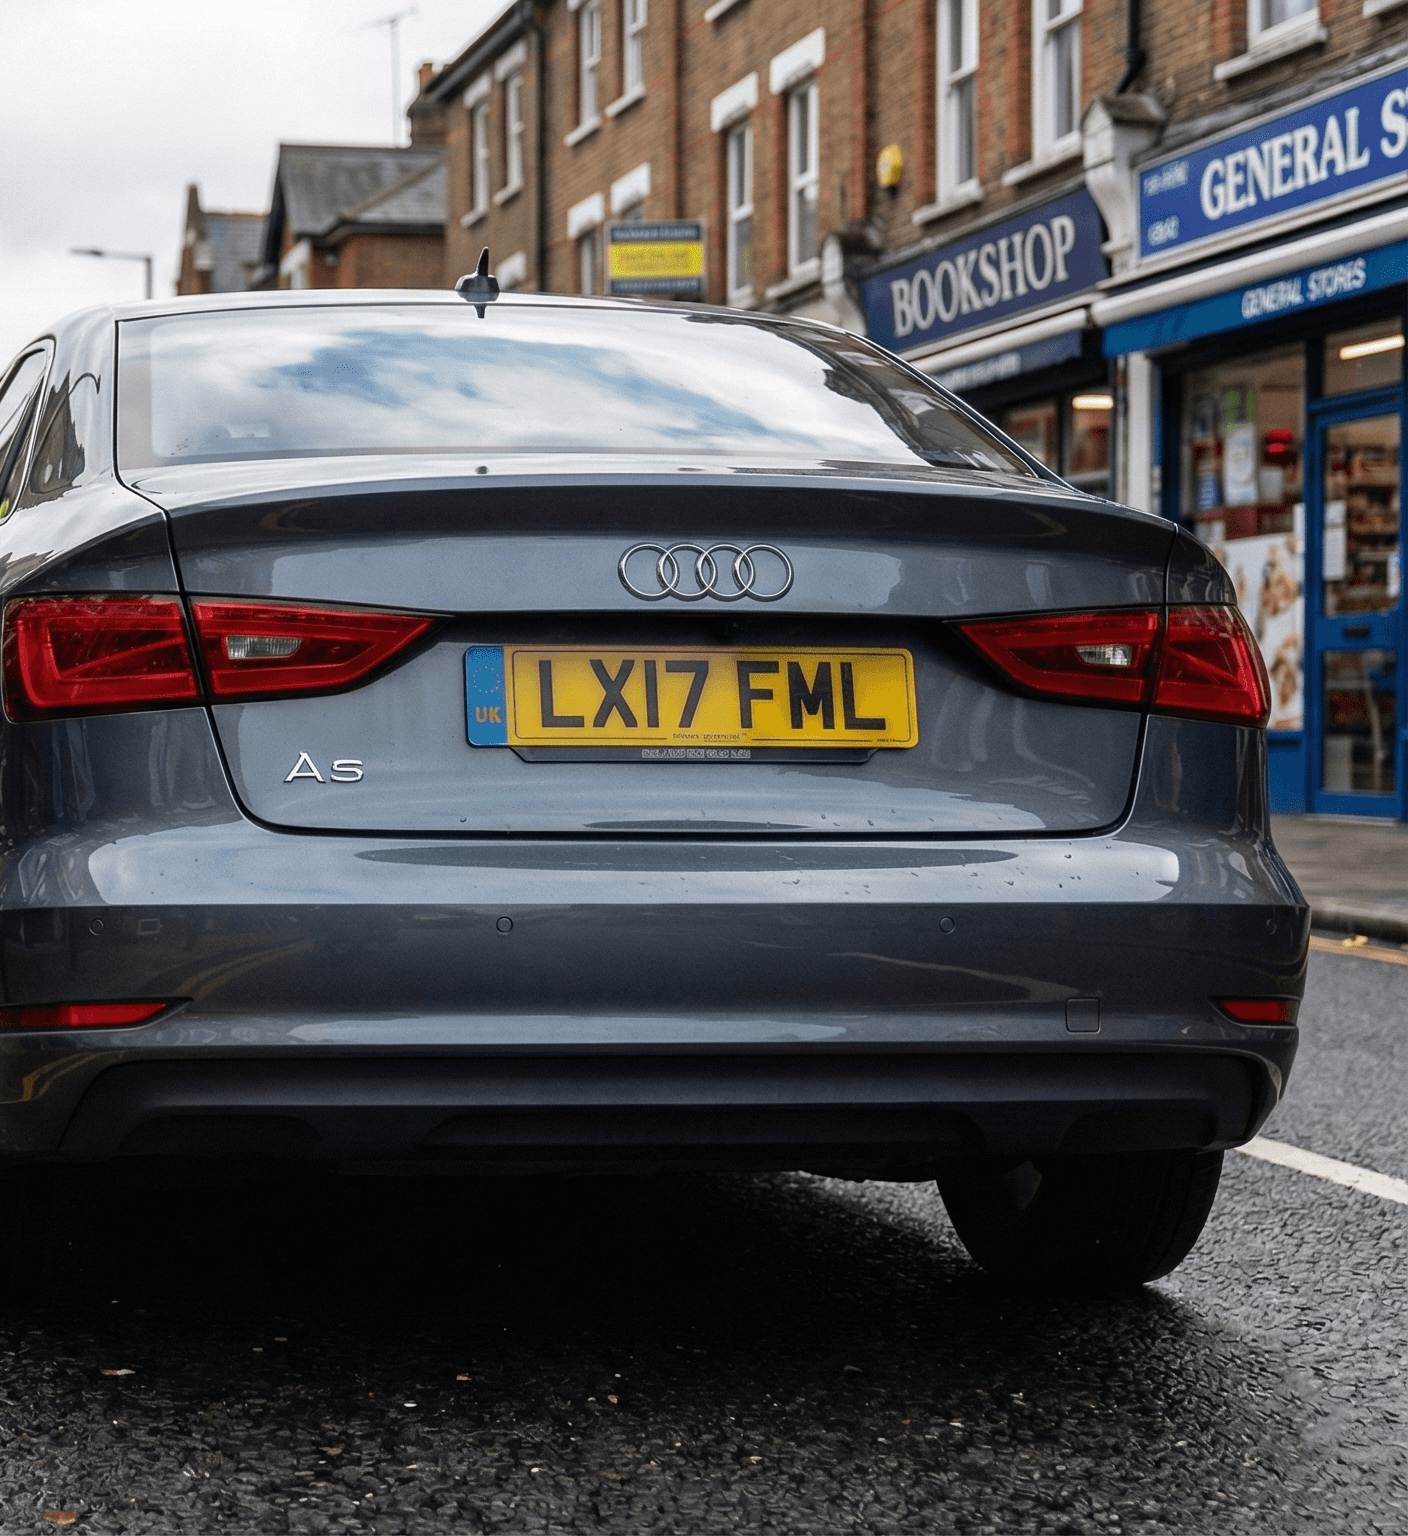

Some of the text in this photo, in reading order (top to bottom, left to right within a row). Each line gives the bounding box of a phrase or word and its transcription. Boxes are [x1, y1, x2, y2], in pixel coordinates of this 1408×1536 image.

[1200, 86, 1408, 221] GENERAL S
[890, 214, 1075, 338] BOOKSHOP
[474, 706, 503, 724] UK
[538, 659, 886, 731] LX17 FML
